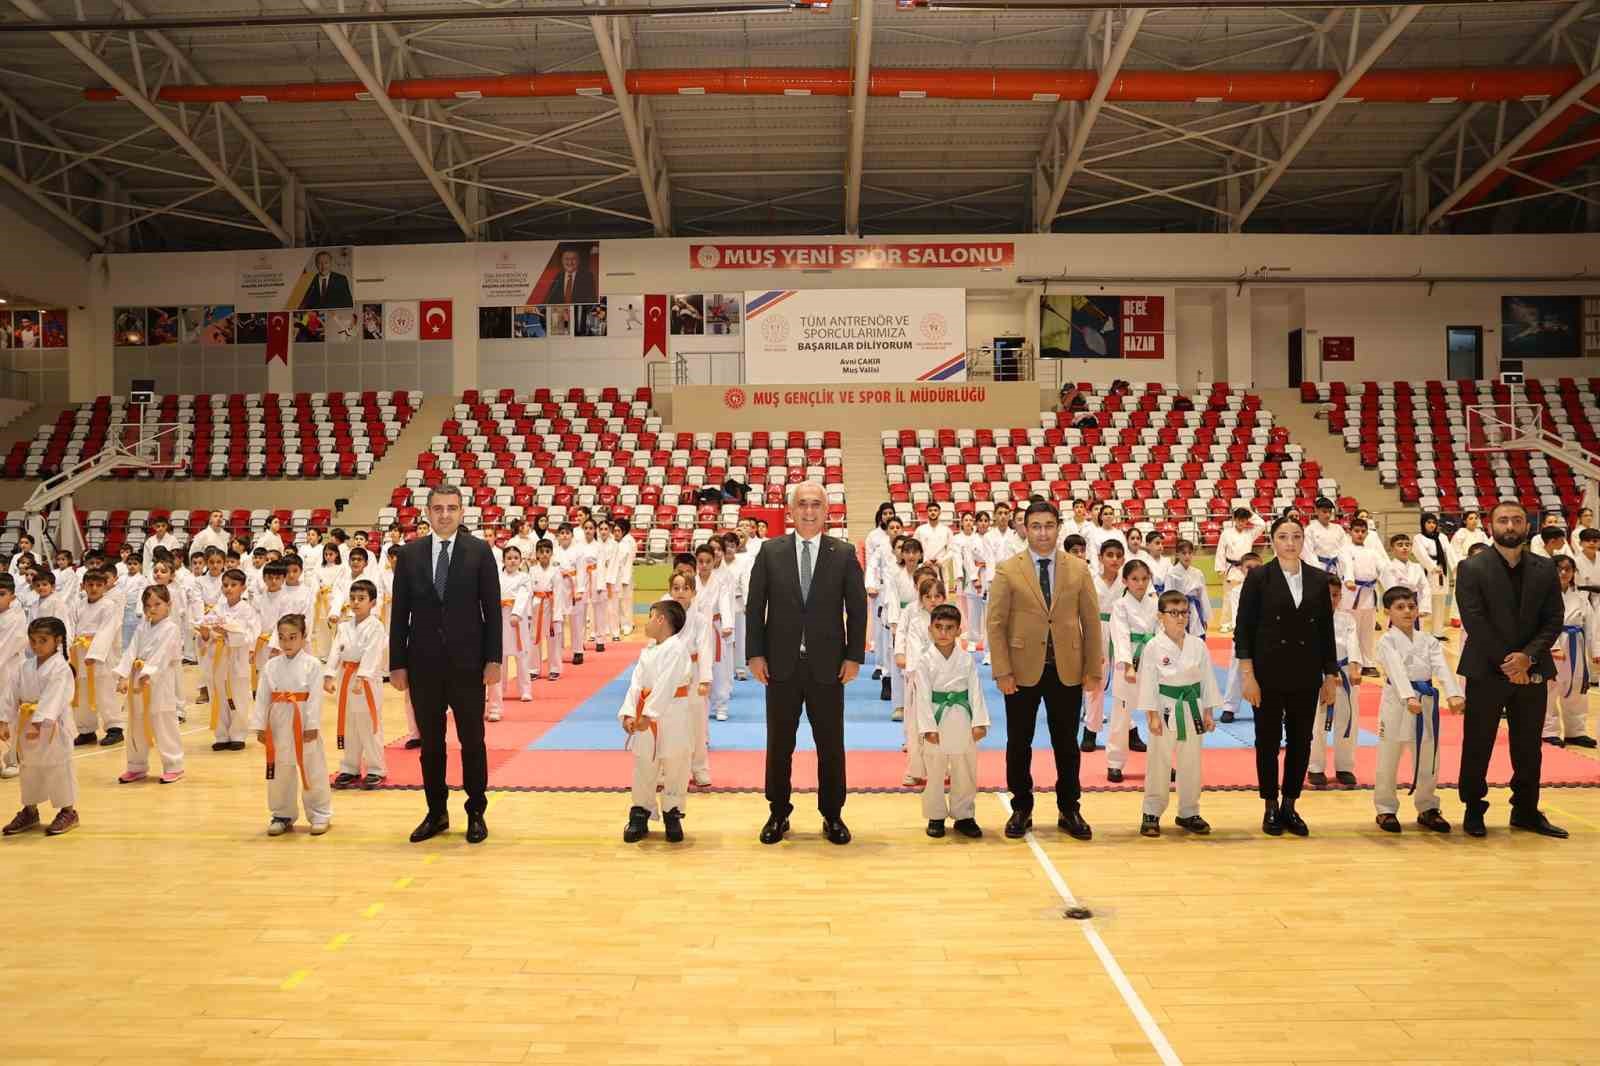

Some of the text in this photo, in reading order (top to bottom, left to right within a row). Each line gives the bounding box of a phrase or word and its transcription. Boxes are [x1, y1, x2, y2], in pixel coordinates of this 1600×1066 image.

[724, 245, 1004, 268] MUŞ YENİ SPOR SALONU
[800, 314, 910, 328] TÜM ANTRENÖR VE
[803, 327, 907, 339] SPORCULARIMIZA
[797, 341, 854, 352] BAŞARILAR
[856, 340, 913, 350] DİLİYORUM
[753, 386, 986, 408] MUŞ GENÇLİK VE SPOR İL MÜDÜRLÜĞÜ
